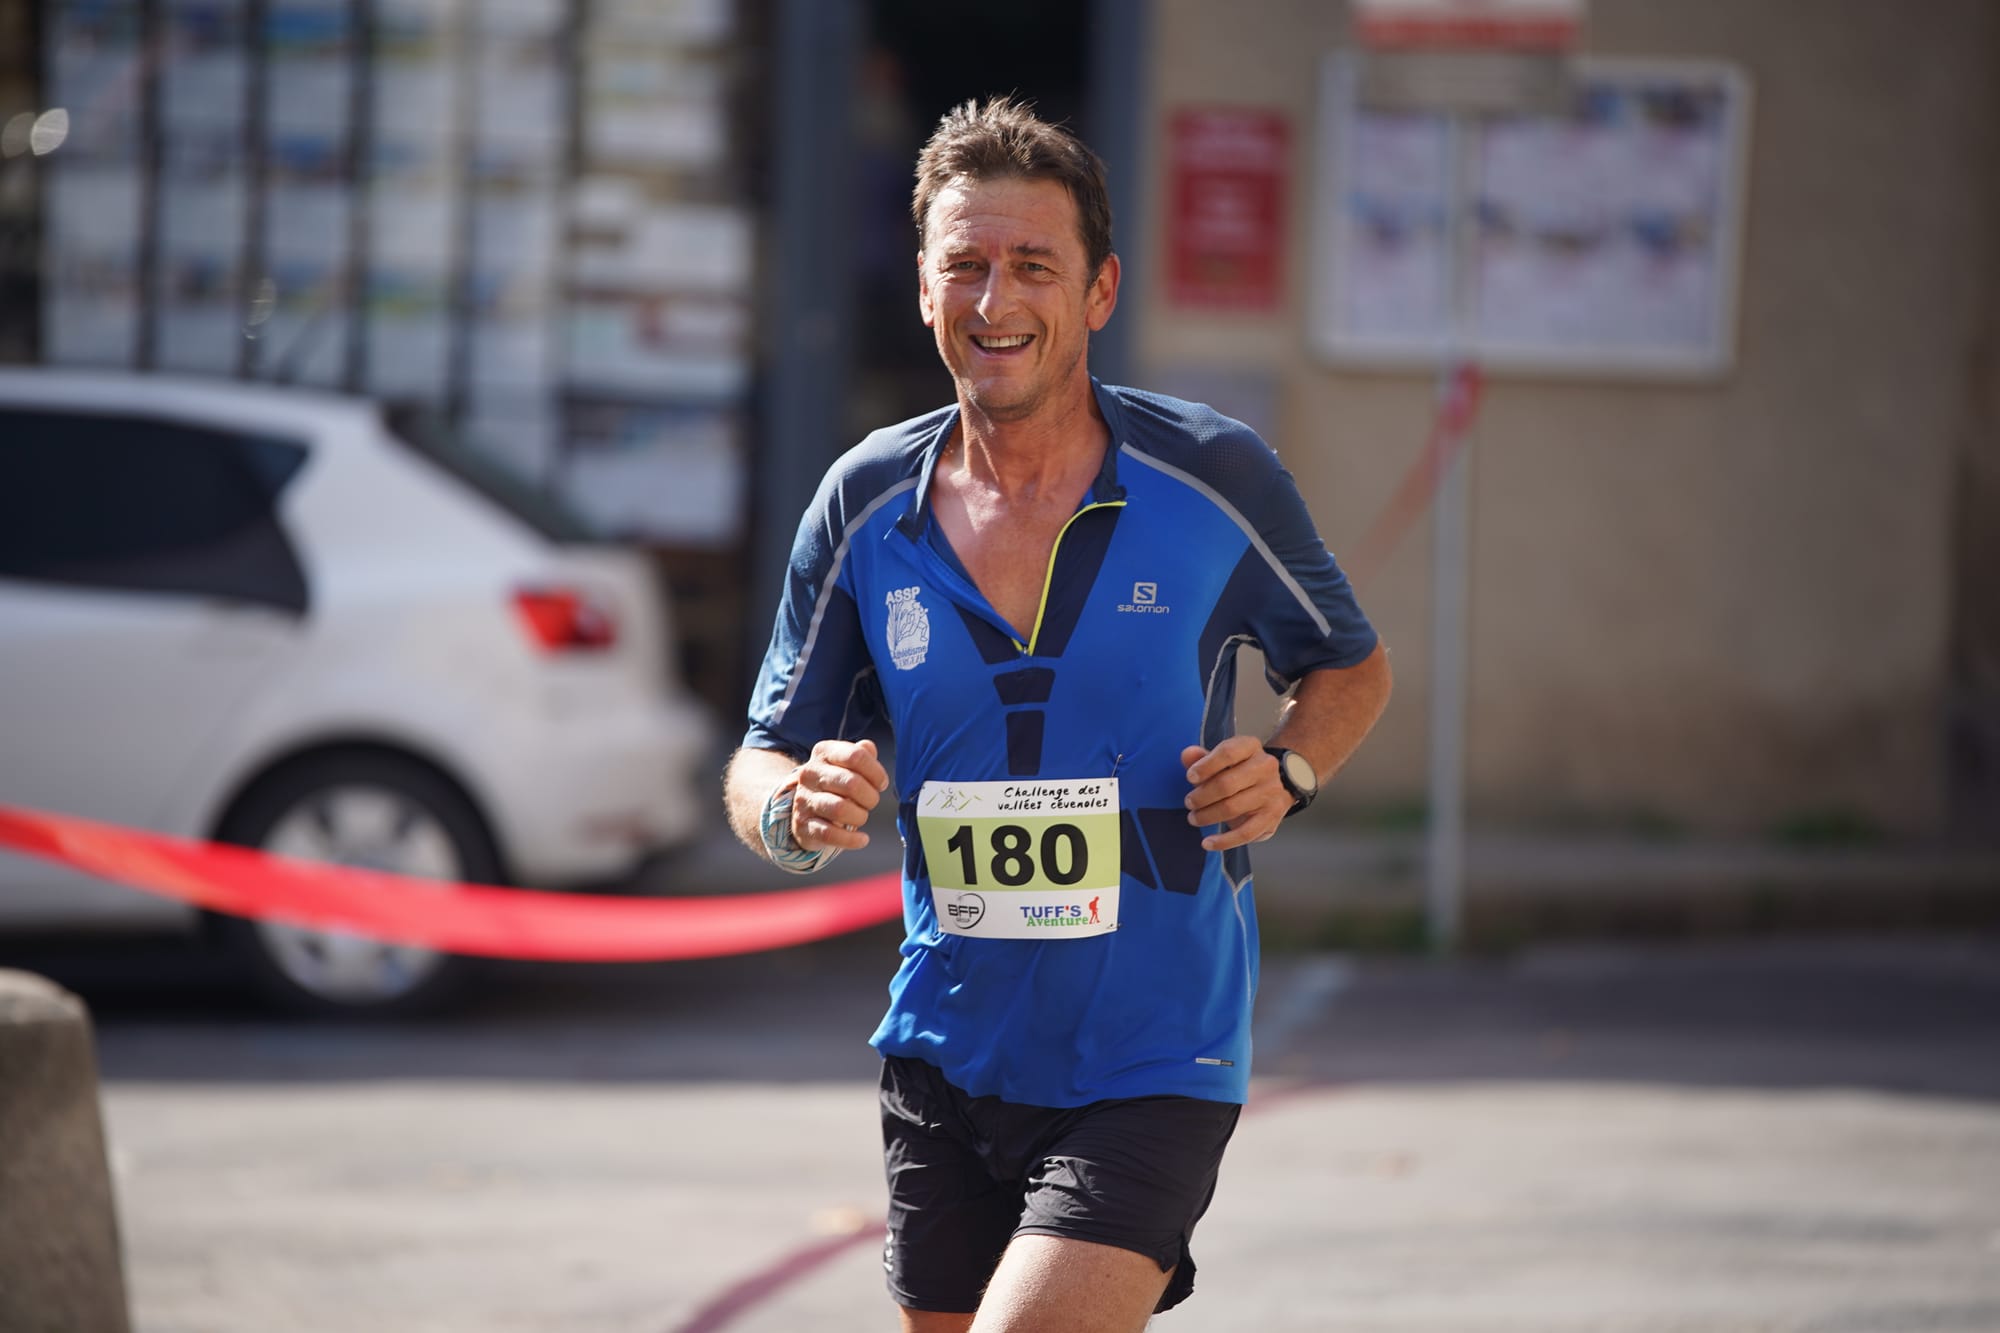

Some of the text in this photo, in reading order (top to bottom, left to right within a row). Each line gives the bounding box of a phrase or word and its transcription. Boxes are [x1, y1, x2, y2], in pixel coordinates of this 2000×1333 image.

[885, 586, 920, 606] ASSP
[1004, 783, 1101, 800] Challenge des
[998, 797, 1108, 811] vallées cévenoles
[947, 823, 1088, 887] 180
[948, 903, 979, 918] BFP
[1020, 905, 1082, 918] TUFF'S
[1026, 916, 1088, 927] Aventure
